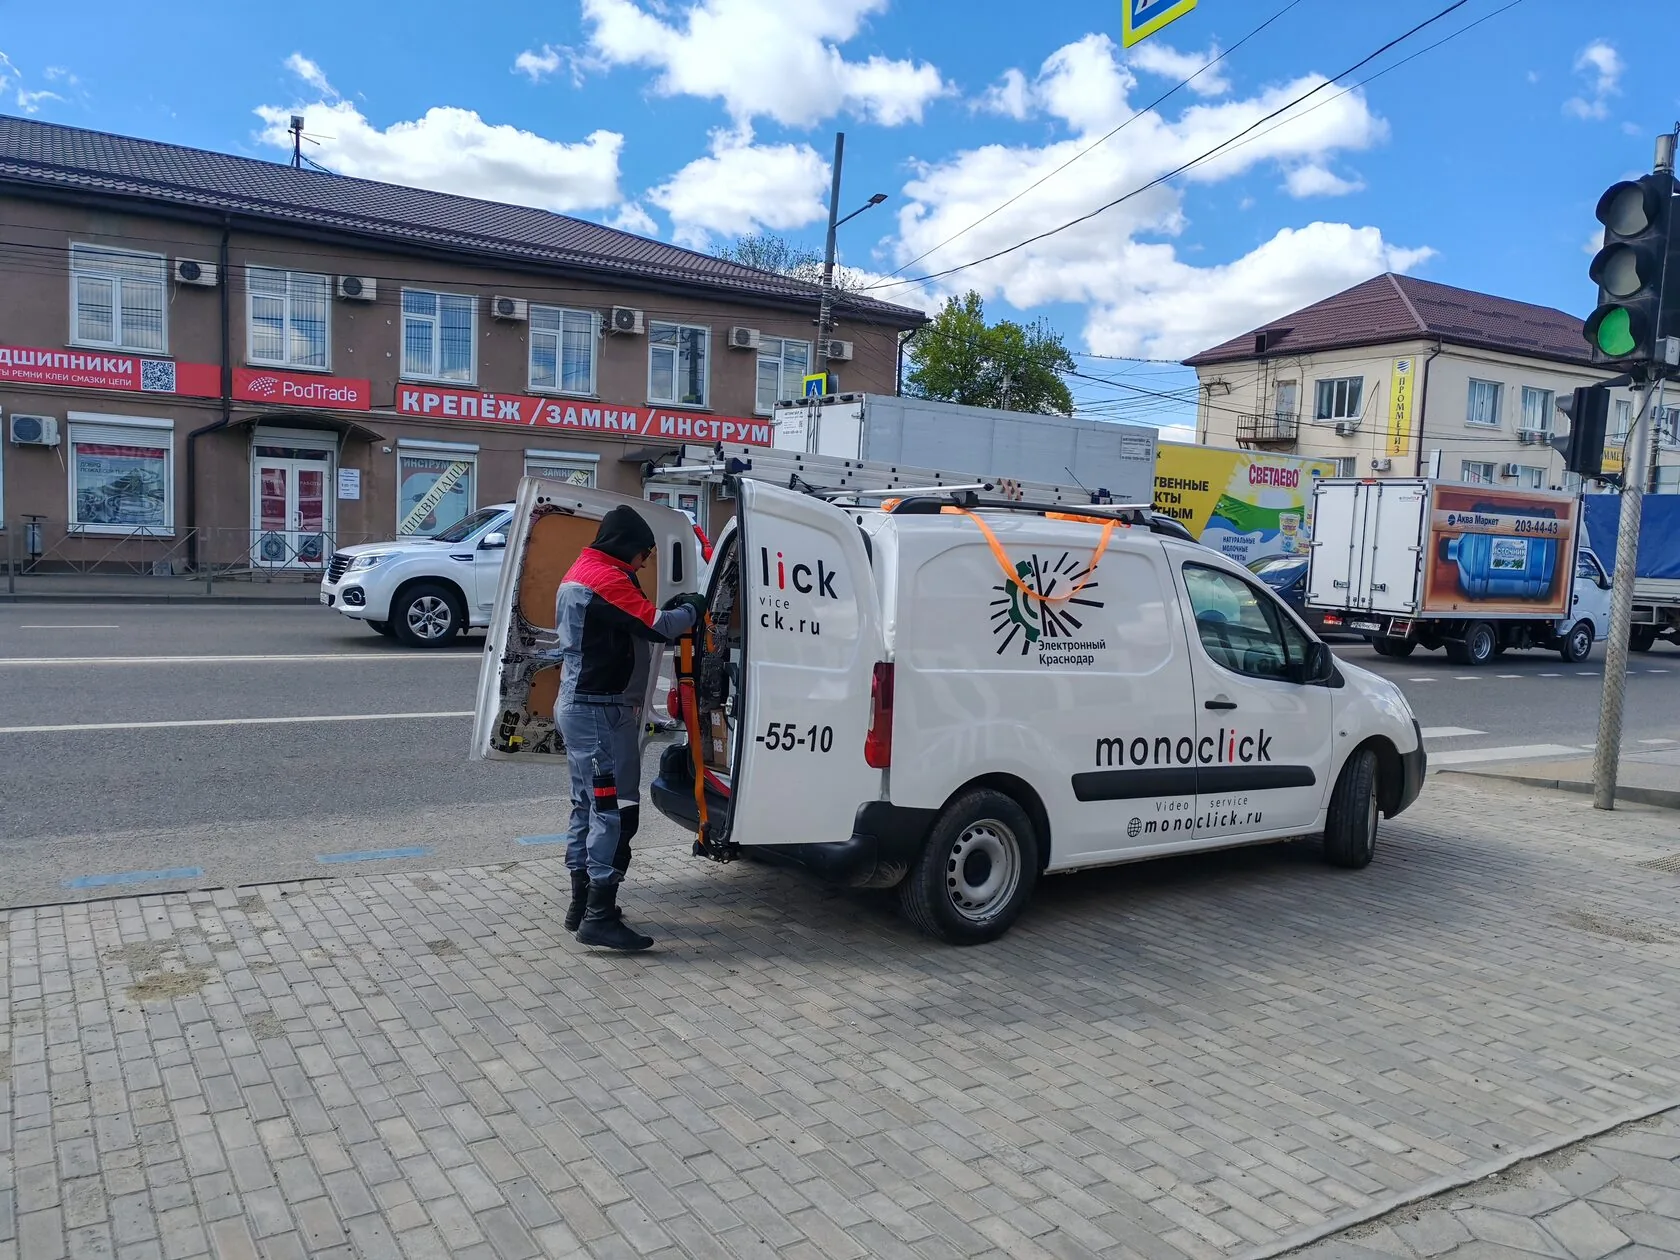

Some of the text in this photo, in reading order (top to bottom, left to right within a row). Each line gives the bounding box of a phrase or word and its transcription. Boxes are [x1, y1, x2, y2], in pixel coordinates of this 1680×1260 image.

[12, 370, 43, 379] РЕМНИ
[71, 374, 106, 384] СМАЗКИ
[108, 377, 132, 386] ЦЕПИ
[283, 381, 357, 402] PodTrade
[402, 391, 521, 421] КРЕПЁЖ
[660, 415, 769, 443] ИНСТРУМ
[1249, 464, 1299, 488] СВЕТАЕВО
[1457, 514, 1474, 524] Аква
[1474, 515, 1499, 526] Маркет
[761, 546, 838, 599] lick
[760, 595, 790, 609] vice
[760, 611, 820, 635] ck.ru
[1038, 639, 1106, 652] Электронный
[1039, 653, 1095, 666] Краснодар
[1095, 728, 1273, 767] monoclick
[1156, 796, 1248, 812] Video service
[1144, 810, 1263, 834] monoclick.ru
